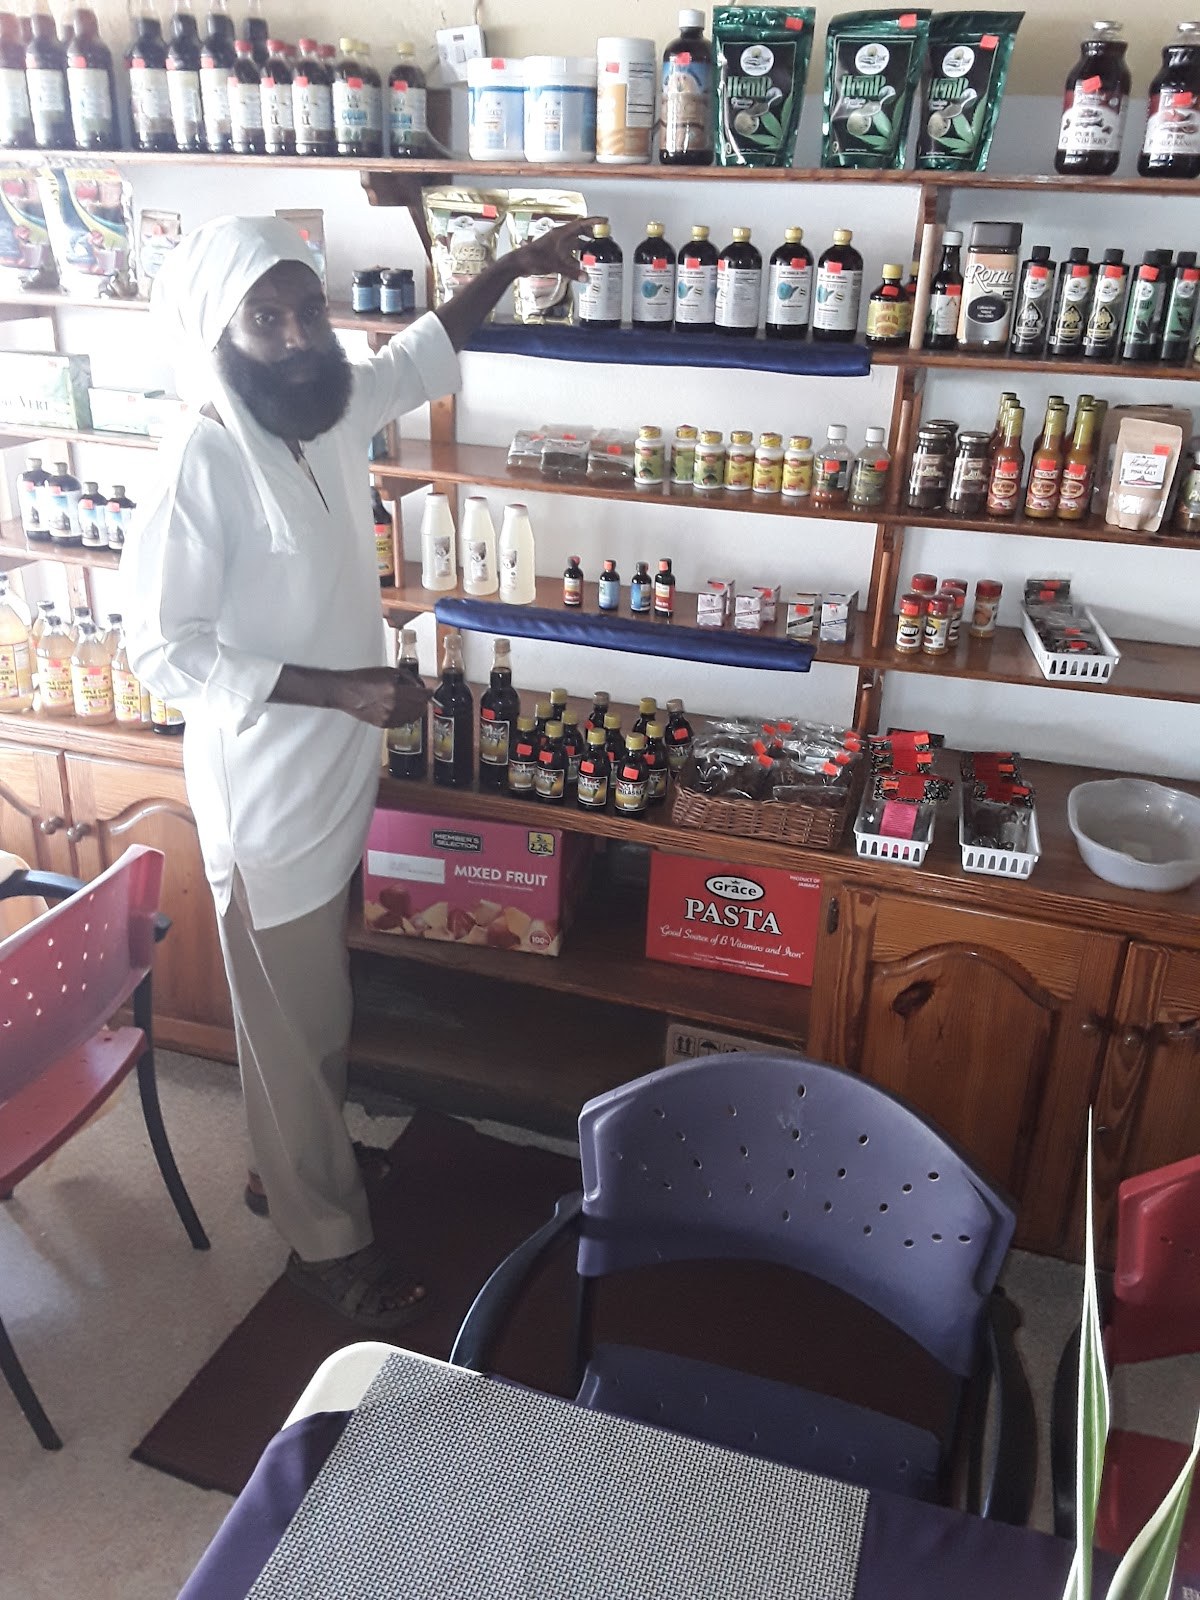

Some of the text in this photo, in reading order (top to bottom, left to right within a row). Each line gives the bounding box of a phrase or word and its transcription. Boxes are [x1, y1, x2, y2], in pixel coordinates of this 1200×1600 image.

[436, 839, 478, 850] SELECTION
[454, 864, 502, 881] MIXED
[505, 870, 548, 887] FRUIT
[789, 874, 813, 883] PRODUCT
[712, 881, 757, 897] Grace
[685, 898, 783, 936] PASTA
[660, 924, 682, 938] Good
[709, 934, 720, 946] of
[729, 936, 764, 952] Vitamins
[765, 945, 781, 955] and
